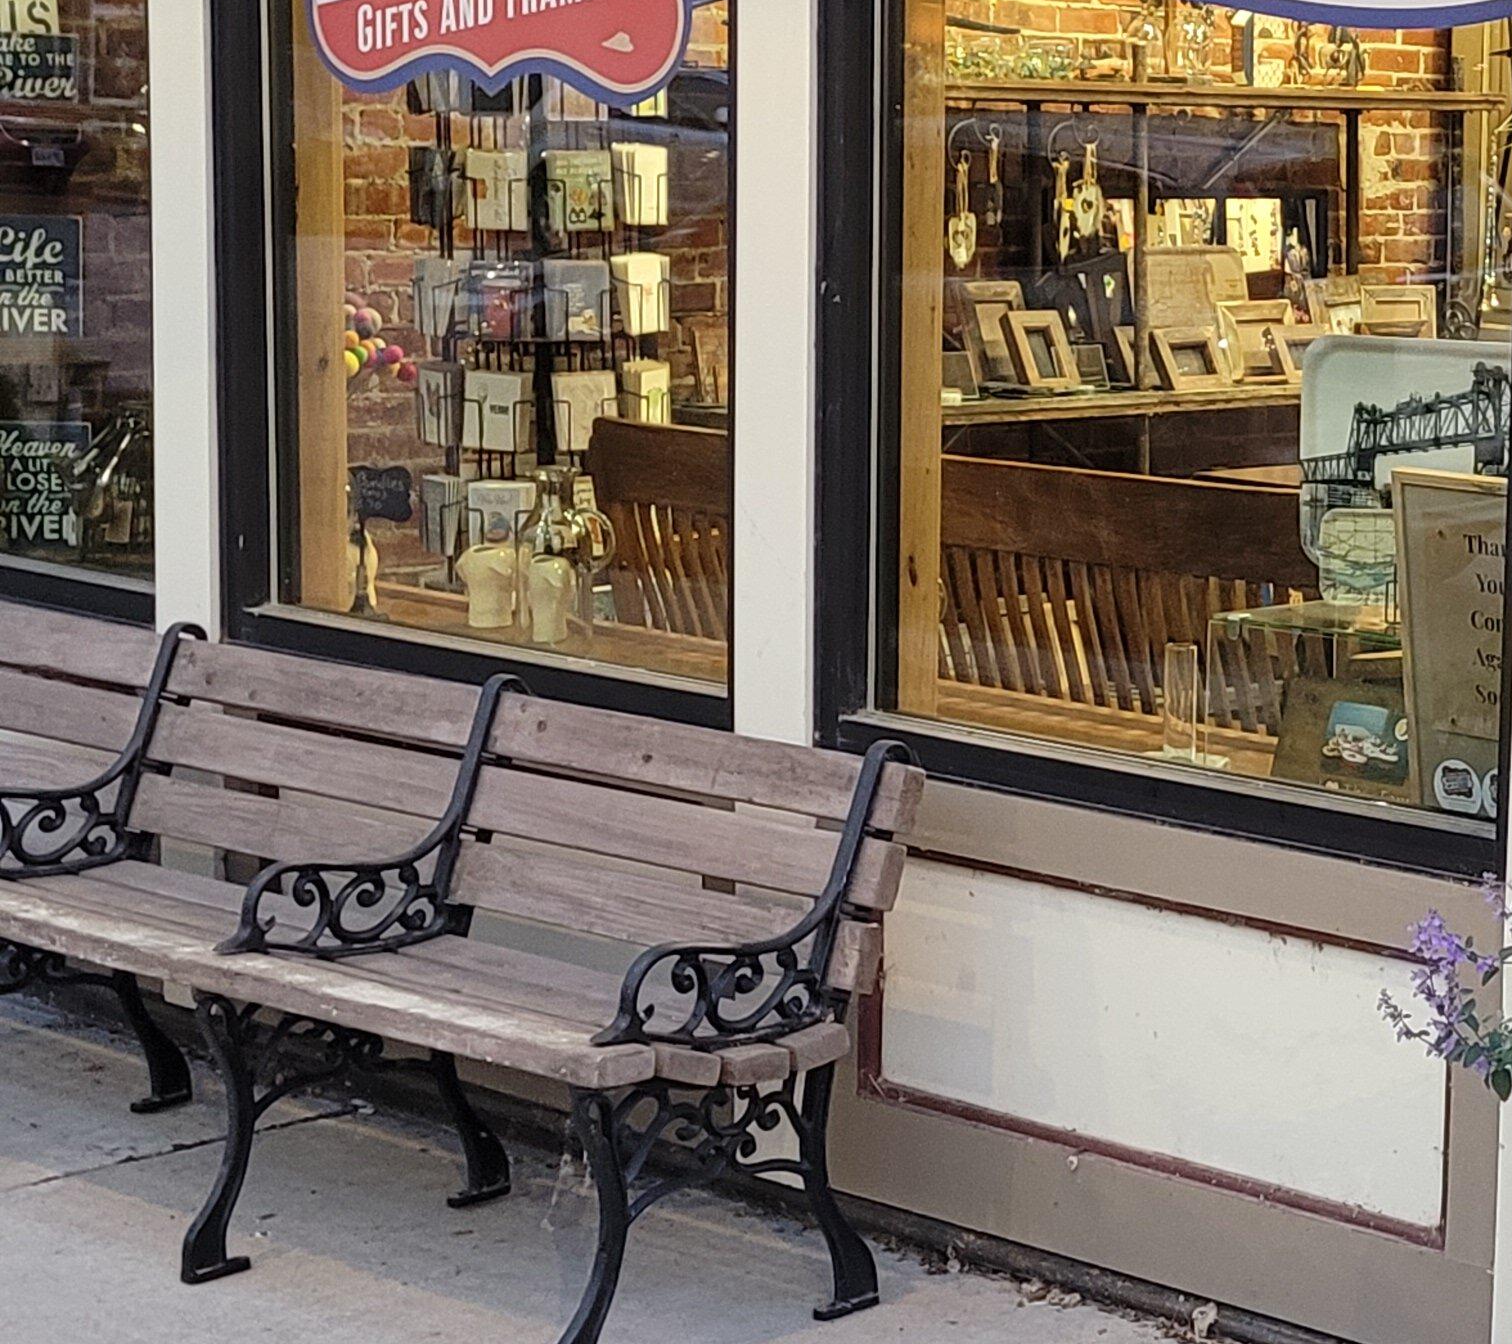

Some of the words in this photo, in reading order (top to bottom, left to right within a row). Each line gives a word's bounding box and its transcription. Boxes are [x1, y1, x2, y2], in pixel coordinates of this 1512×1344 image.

[19, 53, 41, 66] TO
[46, 52, 75, 67] THE
[5, 268, 64, 284] BETTER
[17, 282, 54, 307] the
[0, 307, 69, 334] IVER
[10, 457, 24, 472] A
[28, 457, 56, 472] LIT
[27, 491, 63, 514] the
